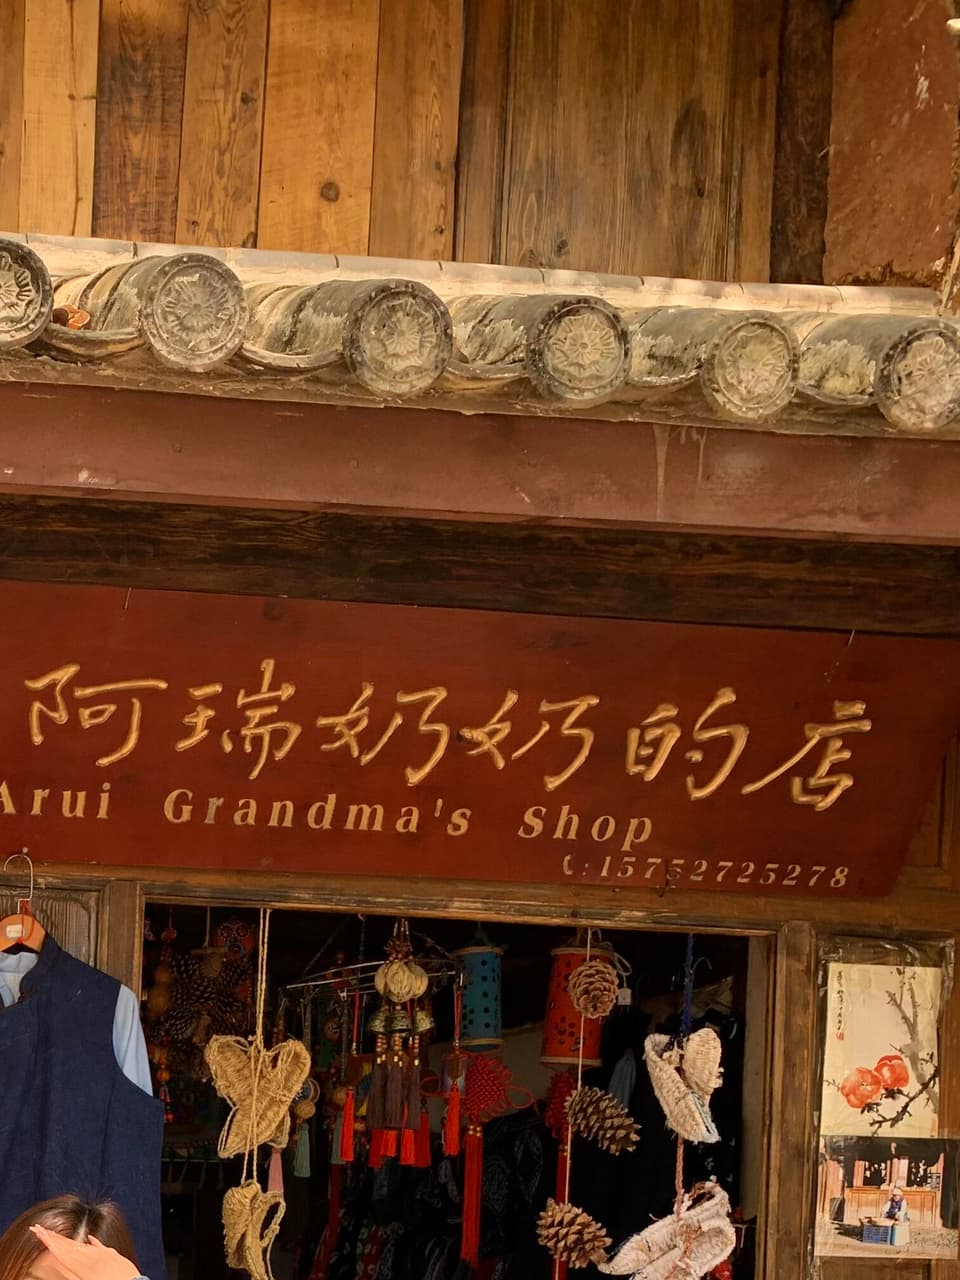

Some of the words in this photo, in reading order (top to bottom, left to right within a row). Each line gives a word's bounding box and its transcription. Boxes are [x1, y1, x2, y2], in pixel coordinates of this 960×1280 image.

[23, 658, 872, 811] 阿瑞奶奶的店
[163, 788, 473, 837] Grandma's
[517, 804, 653, 851] Shop
